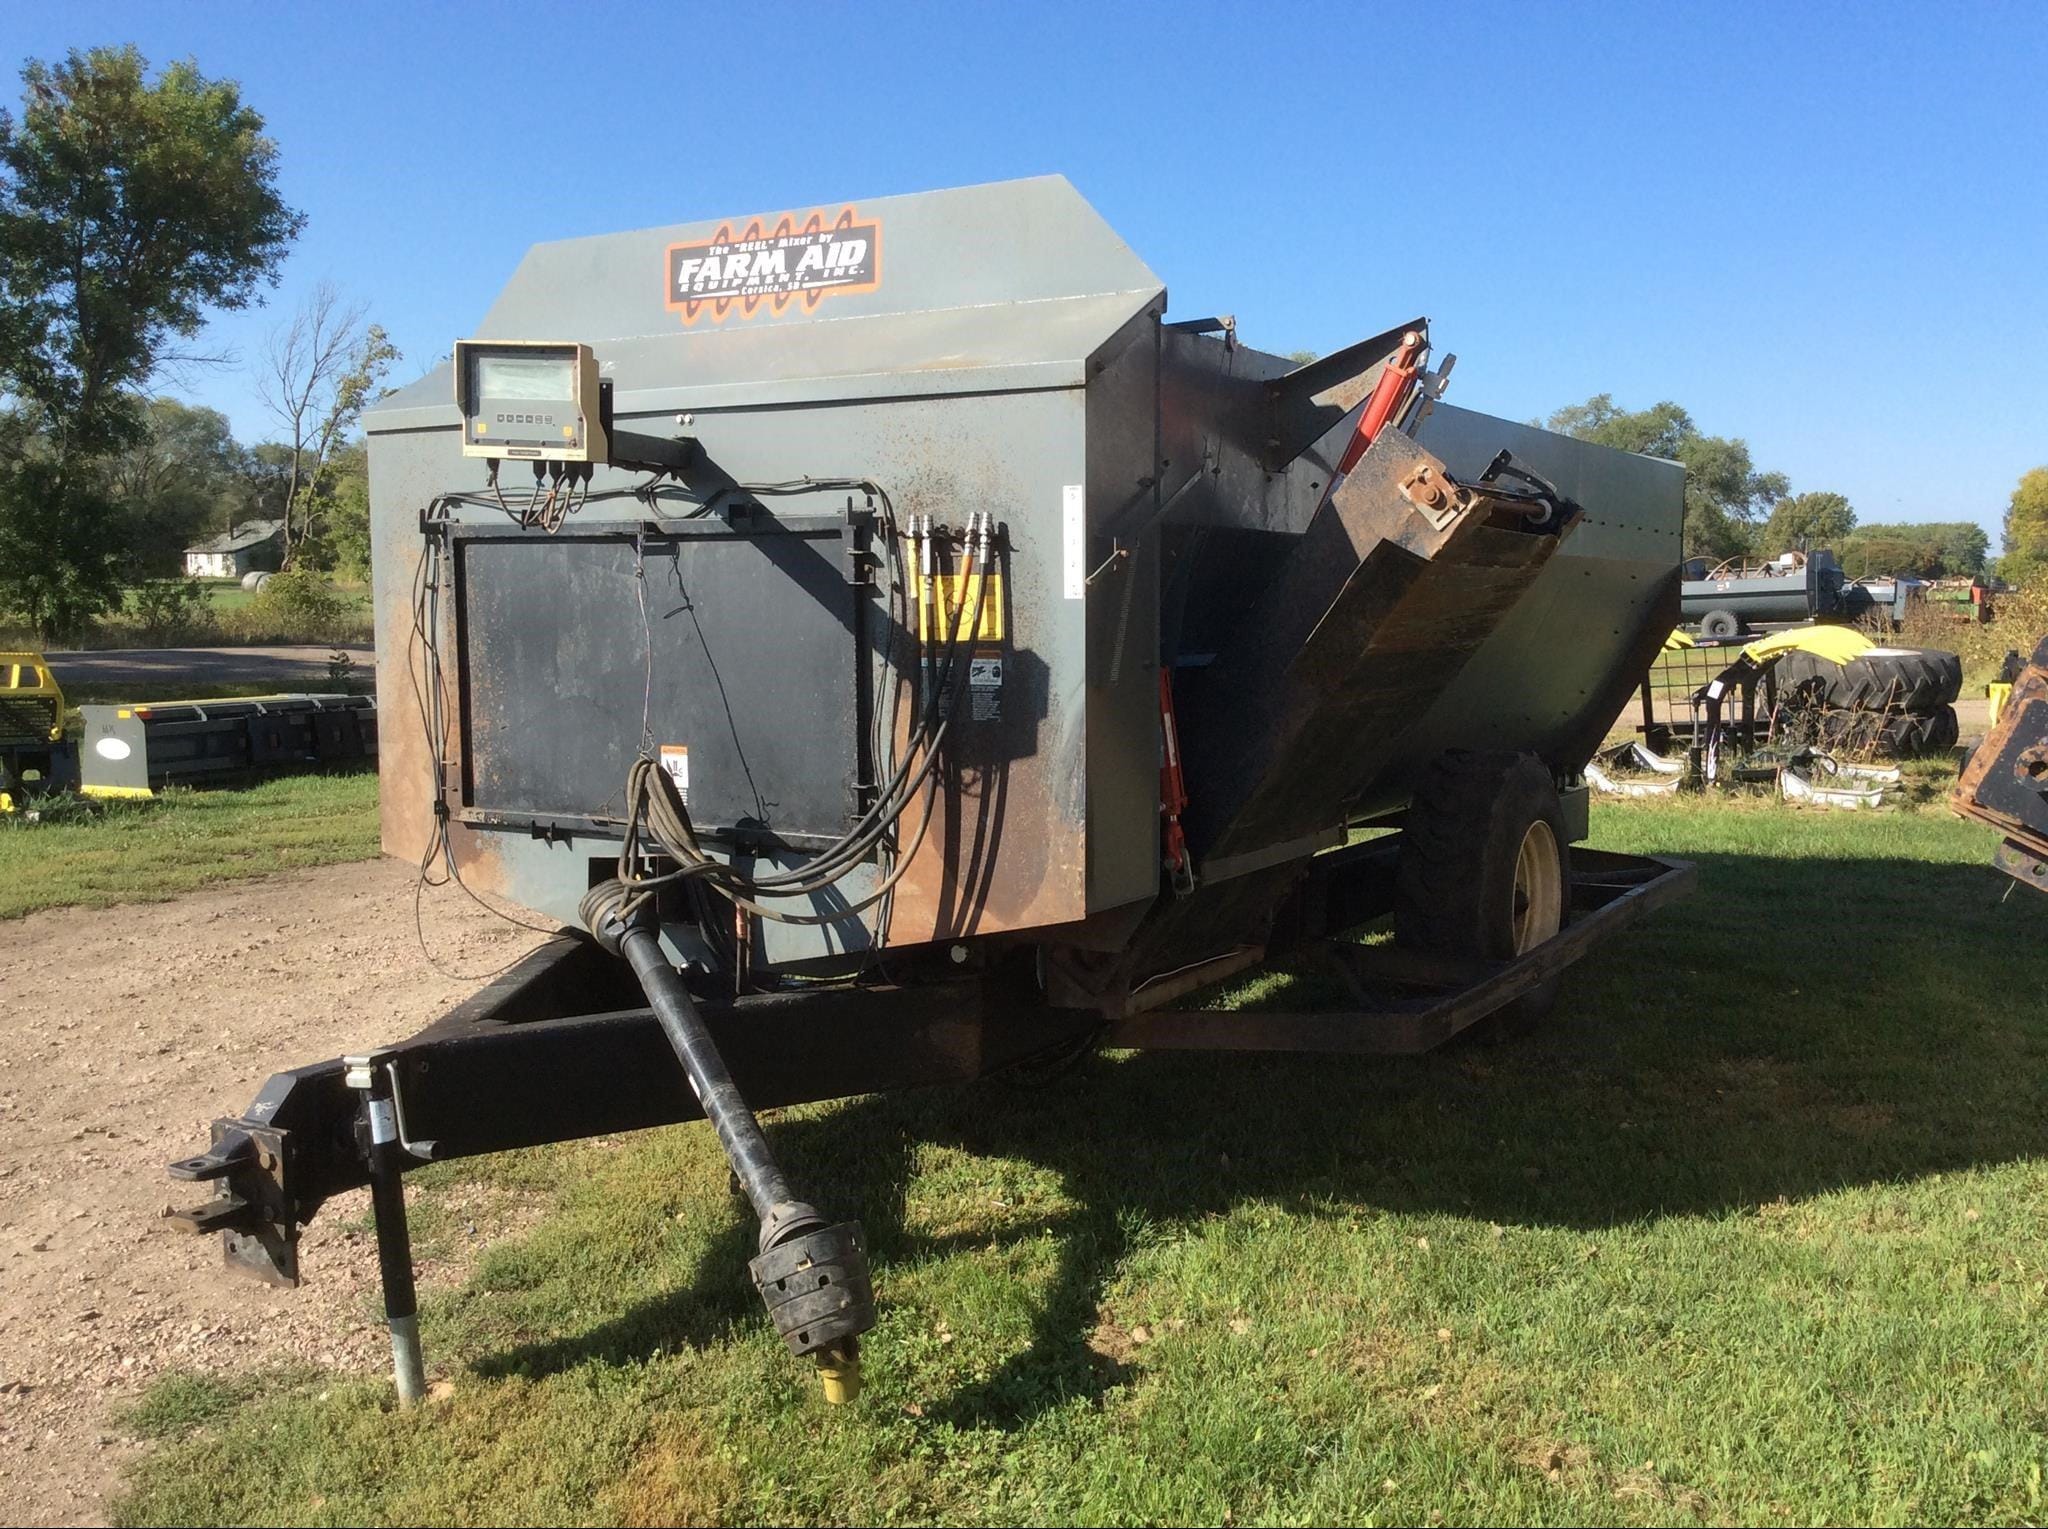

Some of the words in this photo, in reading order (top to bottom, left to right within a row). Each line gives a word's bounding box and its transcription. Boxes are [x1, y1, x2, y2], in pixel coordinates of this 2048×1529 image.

[709, 246, 730, 256] The
[777, 235, 813, 249] Mixer
[818, 233, 834, 244] by
[678, 248, 787, 285] FARM
[795, 239, 867, 273] AID
[823, 265, 865, 279] INC.
